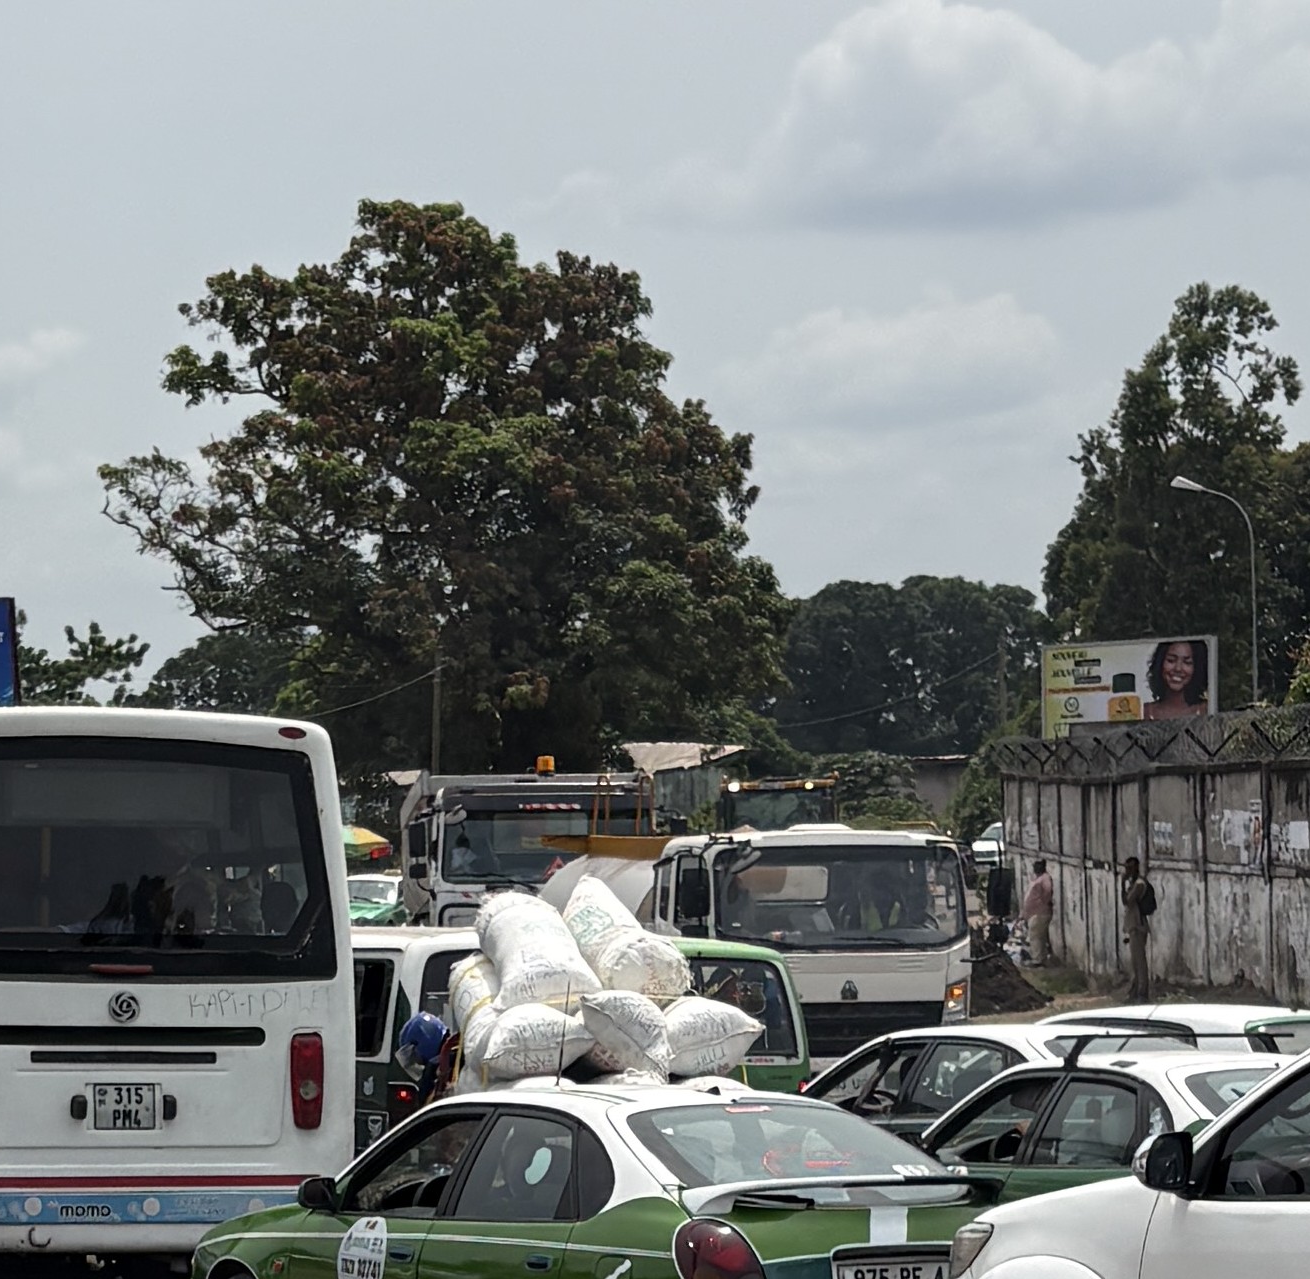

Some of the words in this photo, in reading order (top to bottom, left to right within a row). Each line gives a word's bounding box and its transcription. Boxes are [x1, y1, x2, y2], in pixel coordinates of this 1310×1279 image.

[114, 1087, 143, 1105] 315
[112, 1109, 141, 1128] PM4
[60, 1204, 111, 1218] momo
